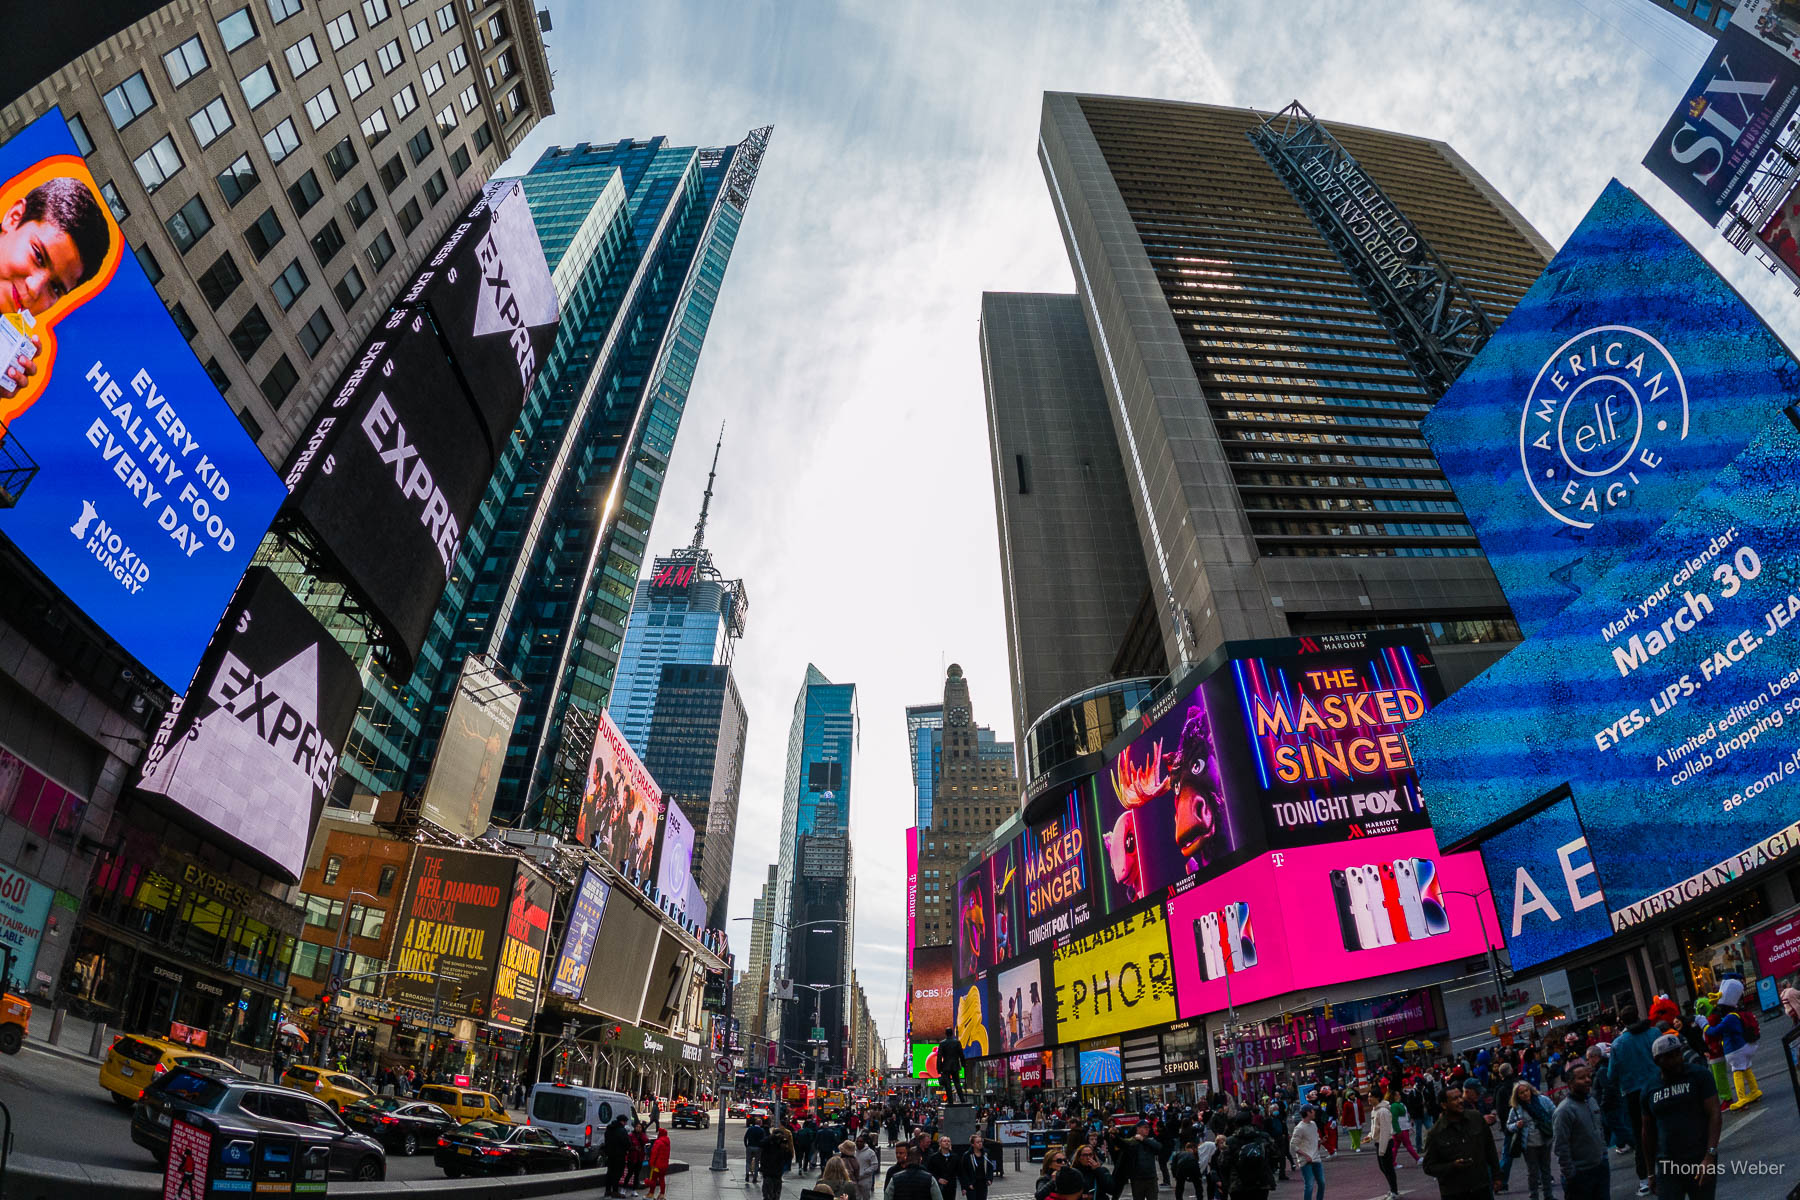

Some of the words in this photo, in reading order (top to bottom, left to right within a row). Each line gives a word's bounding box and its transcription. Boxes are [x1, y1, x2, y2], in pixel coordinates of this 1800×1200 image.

[1671, 54, 1776, 186] SIX
[1728, 149, 1745, 169] THE
[1742, 107, 1774, 148] MUSICAL
[1301, 156, 1346, 203] EAGLE
[468, 181, 505, 218] EXPRESS
[1334, 159, 1418, 253] OUTFITTERS
[430, 222, 472, 267] EXPRESS
[1336, 199, 1417, 289] AMERICAN
[333, 341, 386, 408] EXPRESS
[1532, 342, 1669, 450] AMERICAN
[130, 368, 200, 457] EVERY
[195, 454, 230, 501] KID
[85, 360, 183, 486] HEALTHY
[179, 482, 235, 552] FOOD
[85, 417, 162, 508] EVERY
[158, 504, 205, 558] DAY
[86, 537, 142, 595] HUNGRY
[94, 519, 122, 553] NO
[120, 547, 150, 583] KID
[651, 565, 695, 588] H&M
[1601, 607, 1640, 642] Mark
[1638, 582, 1672, 618] your
[1672, 526, 1739, 587] calendar:
[1611, 590, 1714, 678] March
[1713, 546, 1761, 598] 30
[1321, 632, 1367, 642] MARRIOTT
[1324, 640, 1365, 650] MARQUIS
[1307, 669, 1358, 690] THE
[1594, 708, 1651, 752] EYES.
[1649, 674, 1701, 717] LIPS.
[1699, 629, 1764, 682] FACE.
[1765, 587, 1800, 637] JEA
[1152, 687, 1178, 713] MARRIOTT
[1153, 699, 1177, 721] MARQUIS
[1256, 689, 1425, 737] MASKED
[141, 693, 185, 779] PRESS
[1656, 755, 1668, 772] A
[1667, 724, 1717, 763] limited
[1718, 692, 1769, 731] edition
[1671, 755, 1713, 787] collab
[1715, 711, 1784, 760] dropping
[1275, 733, 1415, 783] SINGE
[1028, 772, 1051, 790] MARRIOTT
[1028, 782, 1049, 798] MARQUIS
[669, 812, 682, 834] FACE
[1272, 796, 1350, 827] TONIGHT
[1351, 789, 1401, 817] FOX
[1365, 818, 1400, 829] MARRIOTT
[1041, 821, 1059, 844] THE
[1367, 825, 1398, 835] MARQUIS
[423, 856, 444, 879] THE
[1025, 827, 1083, 886] MASKED
[184, 863, 251, 908] EXPRESS
[416, 876, 441, 899] NEIL
[443, 880, 500, 908] DIAMOND
[622, 859, 661, 905] 1540
[1030, 866, 1082, 916] SINGER
[1176, 873, 1196, 888] MARRIOTT
[1177, 880, 1195, 894] MARQUIS
[1511, 835, 1604, 938] AE
[1616, 862, 1736, 931] AMERICAN
[411, 896, 457, 923] MUSICAL
[1074, 910, 1090, 925] hulu
[402, 918, 416, 948] A
[415, 921, 485, 961] BEAUTIFUL
[1028, 921, 1052, 946] TONIGHT
[1051, 912, 1069, 935] FOX
[1772, 941, 1786, 953] Get
[1785, 936, 1800, 947] Broa
[153, 966, 183, 983] EXPRESS
[396, 947, 439, 984] NOISE
[501, 935, 510, 966] A
[507, 937, 541, 979] BEAUTIFUL
[556, 954, 575, 983] LIFE
[575, 965, 587, 988] PI
[1768, 949, 1791, 963] tickets
[196, 981, 223, 996] EXPRESS
[495, 964, 519, 1000] NOISE
[922, 989, 939, 998] CBS
[1170, 1021, 1190, 1031] SEPHORA
[682, 1043, 698, 1061] FOREVER
[1164, 1060, 1200, 1074] SEPHORA
[1653, 1087, 1670, 1103] OLD
[1671, 1082, 1690, 1096] NAVY
